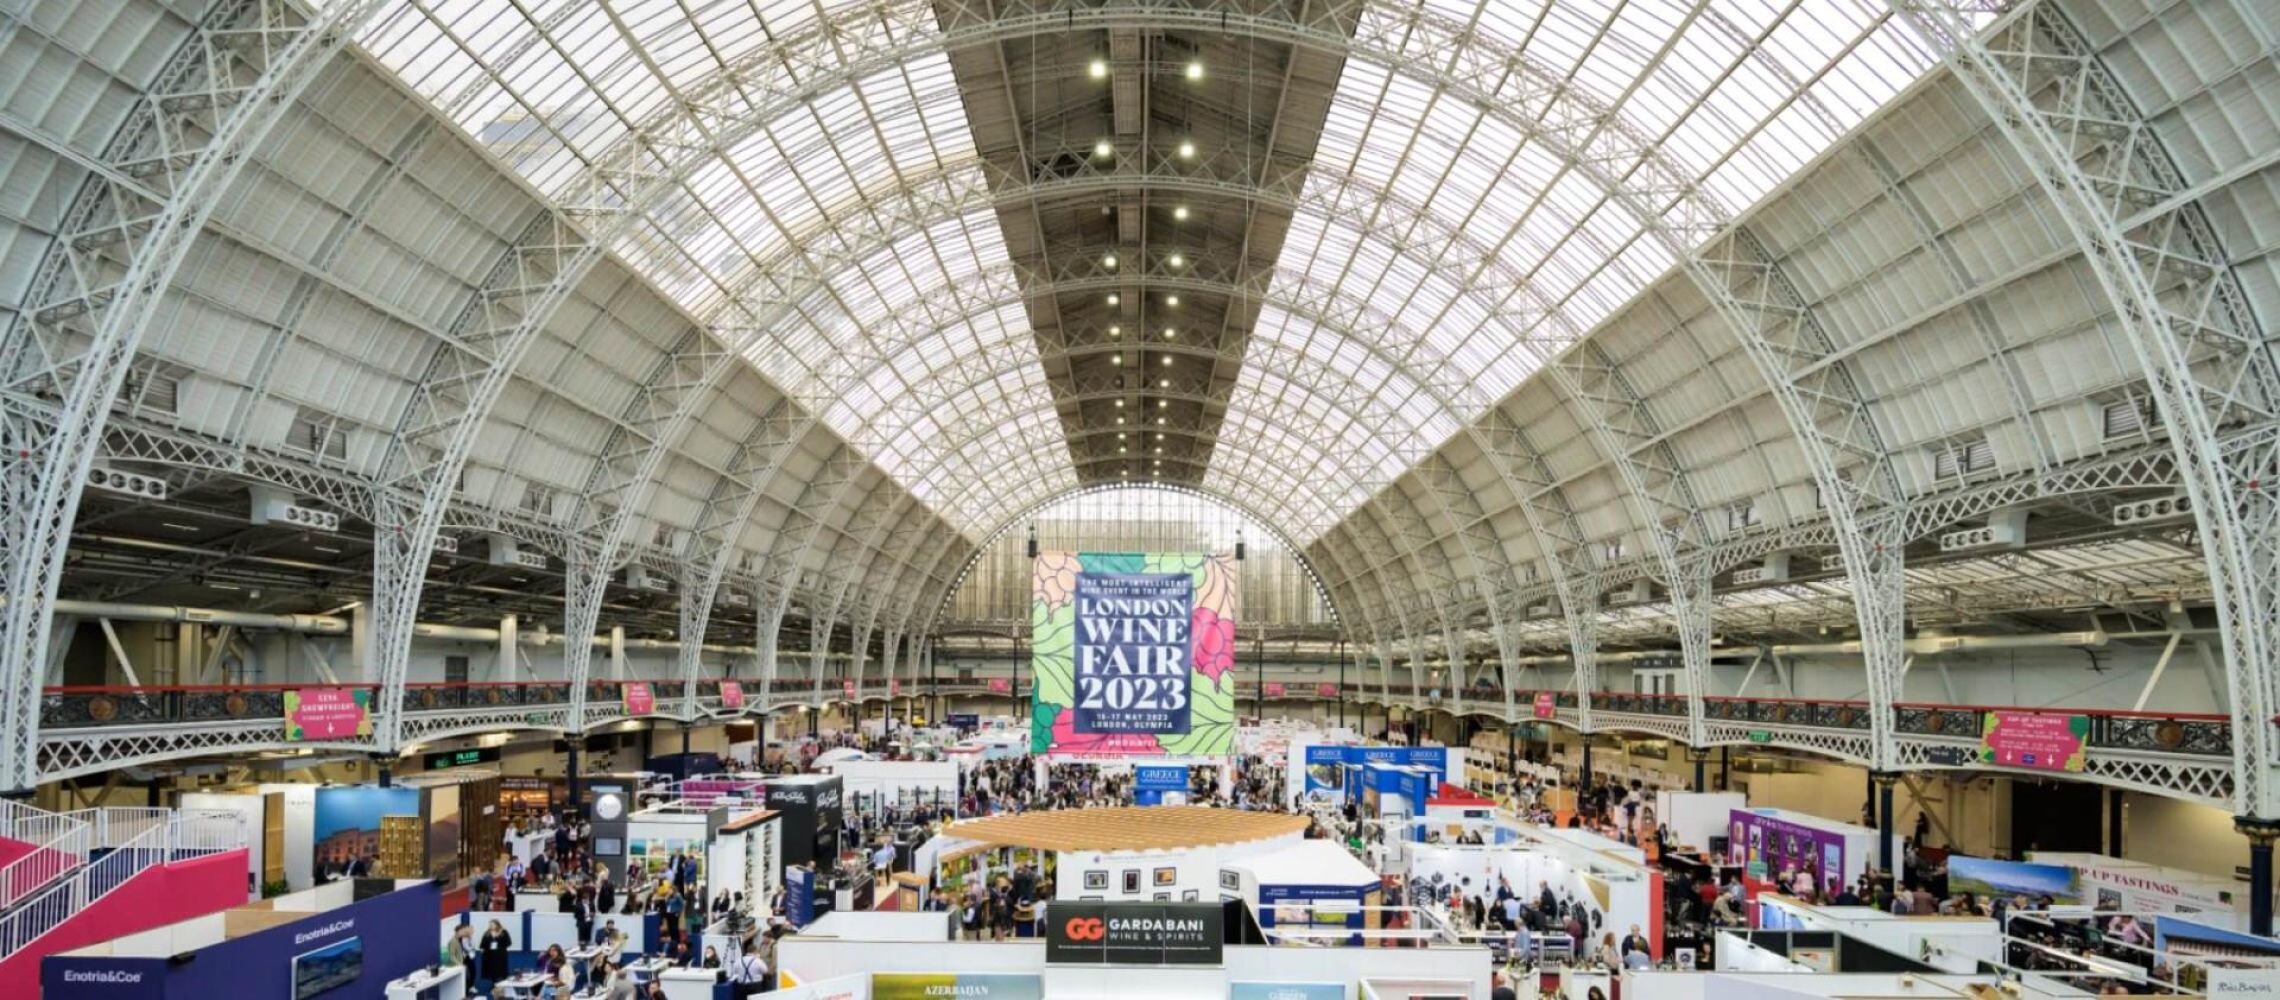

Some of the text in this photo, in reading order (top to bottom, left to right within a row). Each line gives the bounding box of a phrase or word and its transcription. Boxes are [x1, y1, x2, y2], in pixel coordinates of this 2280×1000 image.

[1101, 579, 1125, 587] MOST
[1081, 598, 1186, 616] LONDON
[1082, 618, 1188, 643] WINE
[1081, 645, 1185, 676] FAIR
[1080, 677, 1186, 710] 2023
[1134, 721, 1173, 729] OLYMPIA
[1142, 769, 1181, 779] GREECE
[2114, 873, 2179, 896] TASTINGS
[295, 918, 354, 944] Enotria&Coe
[1065, 917, 1104, 941] GG
[1109, 918, 1204, 931] GARDABANI
[1109, 932, 1139, 941] WINE
[1157, 932, 1204, 941] SPIRITS
[64, 969, 141, 983] Enotria&Coe
[924, 985, 989, 996] AZERBAIJAN
